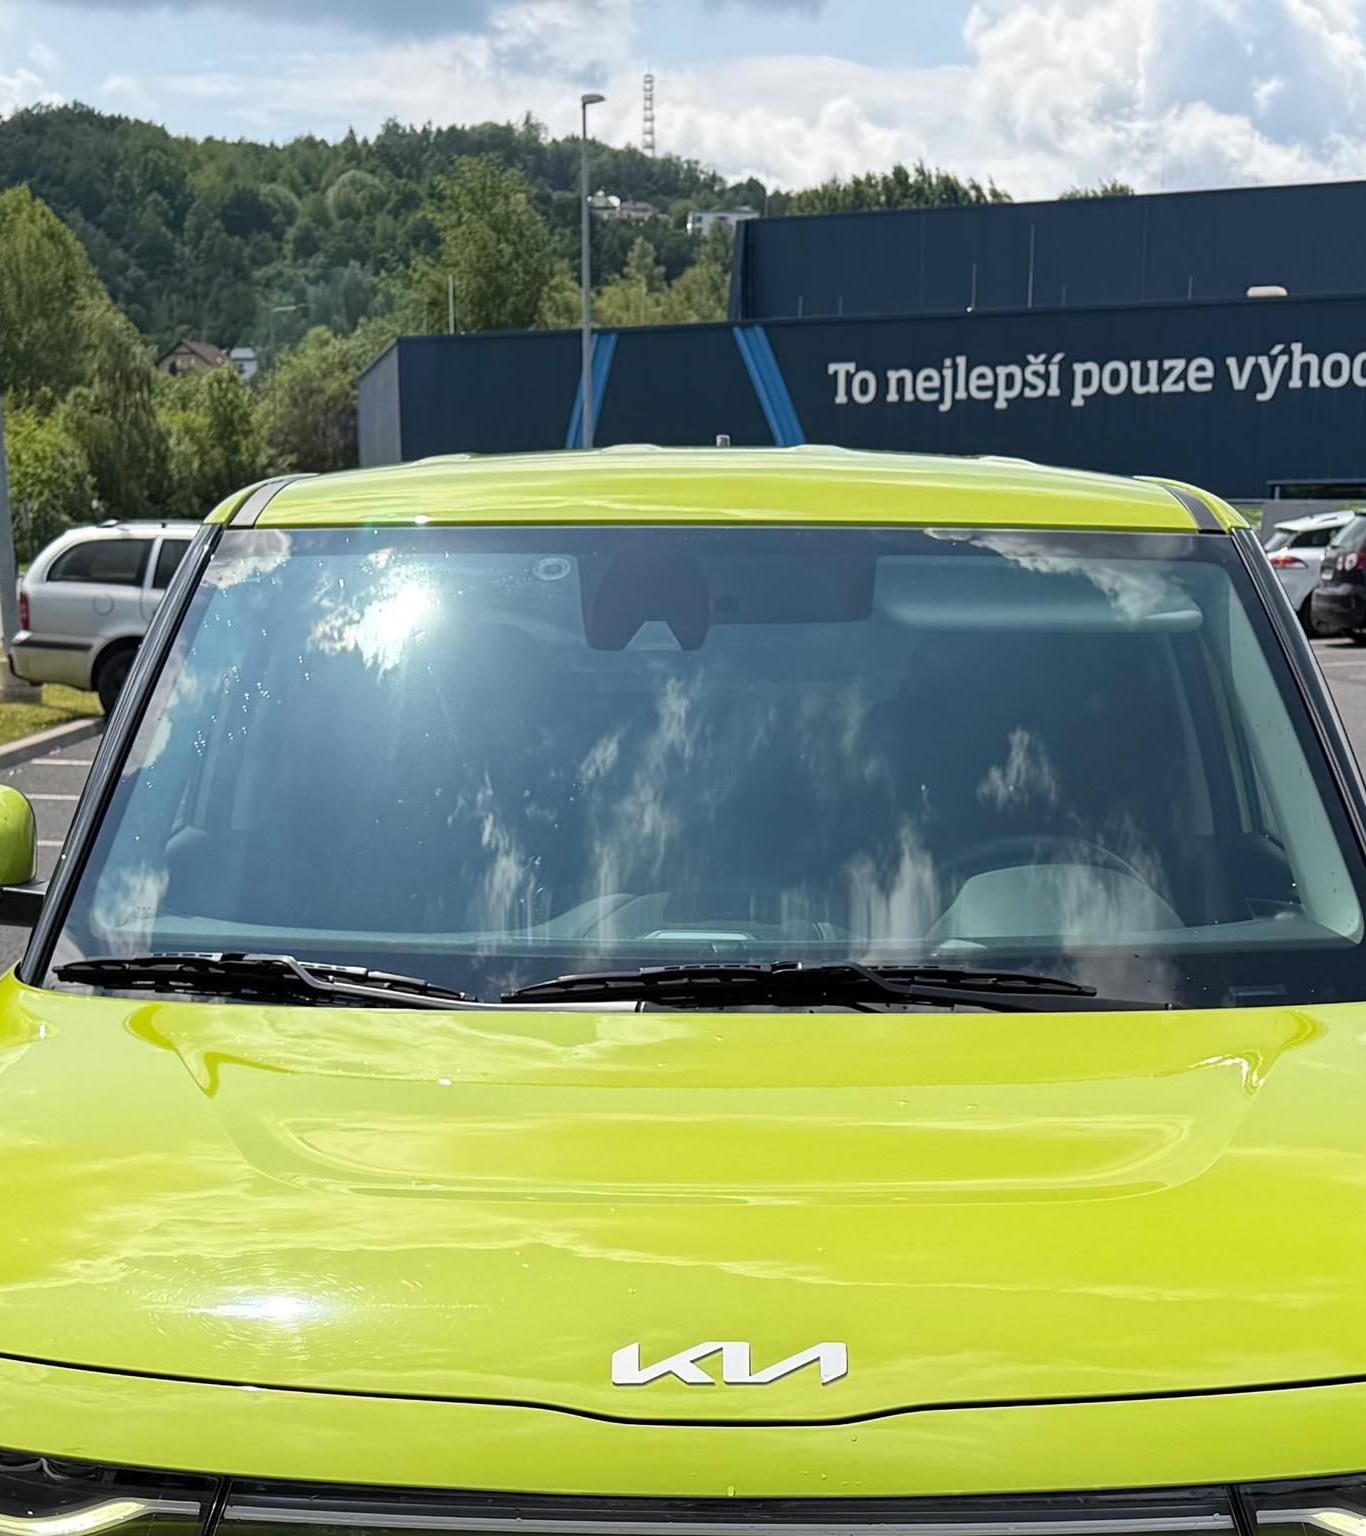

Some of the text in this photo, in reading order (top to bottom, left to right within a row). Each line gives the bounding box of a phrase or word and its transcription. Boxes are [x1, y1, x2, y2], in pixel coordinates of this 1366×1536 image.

[828, 362, 877, 404] To
[886, 352, 1065, 412] nejlepší
[1071, 357, 1215, 407] pouze
[611, 1341, 848, 1386] KIA
